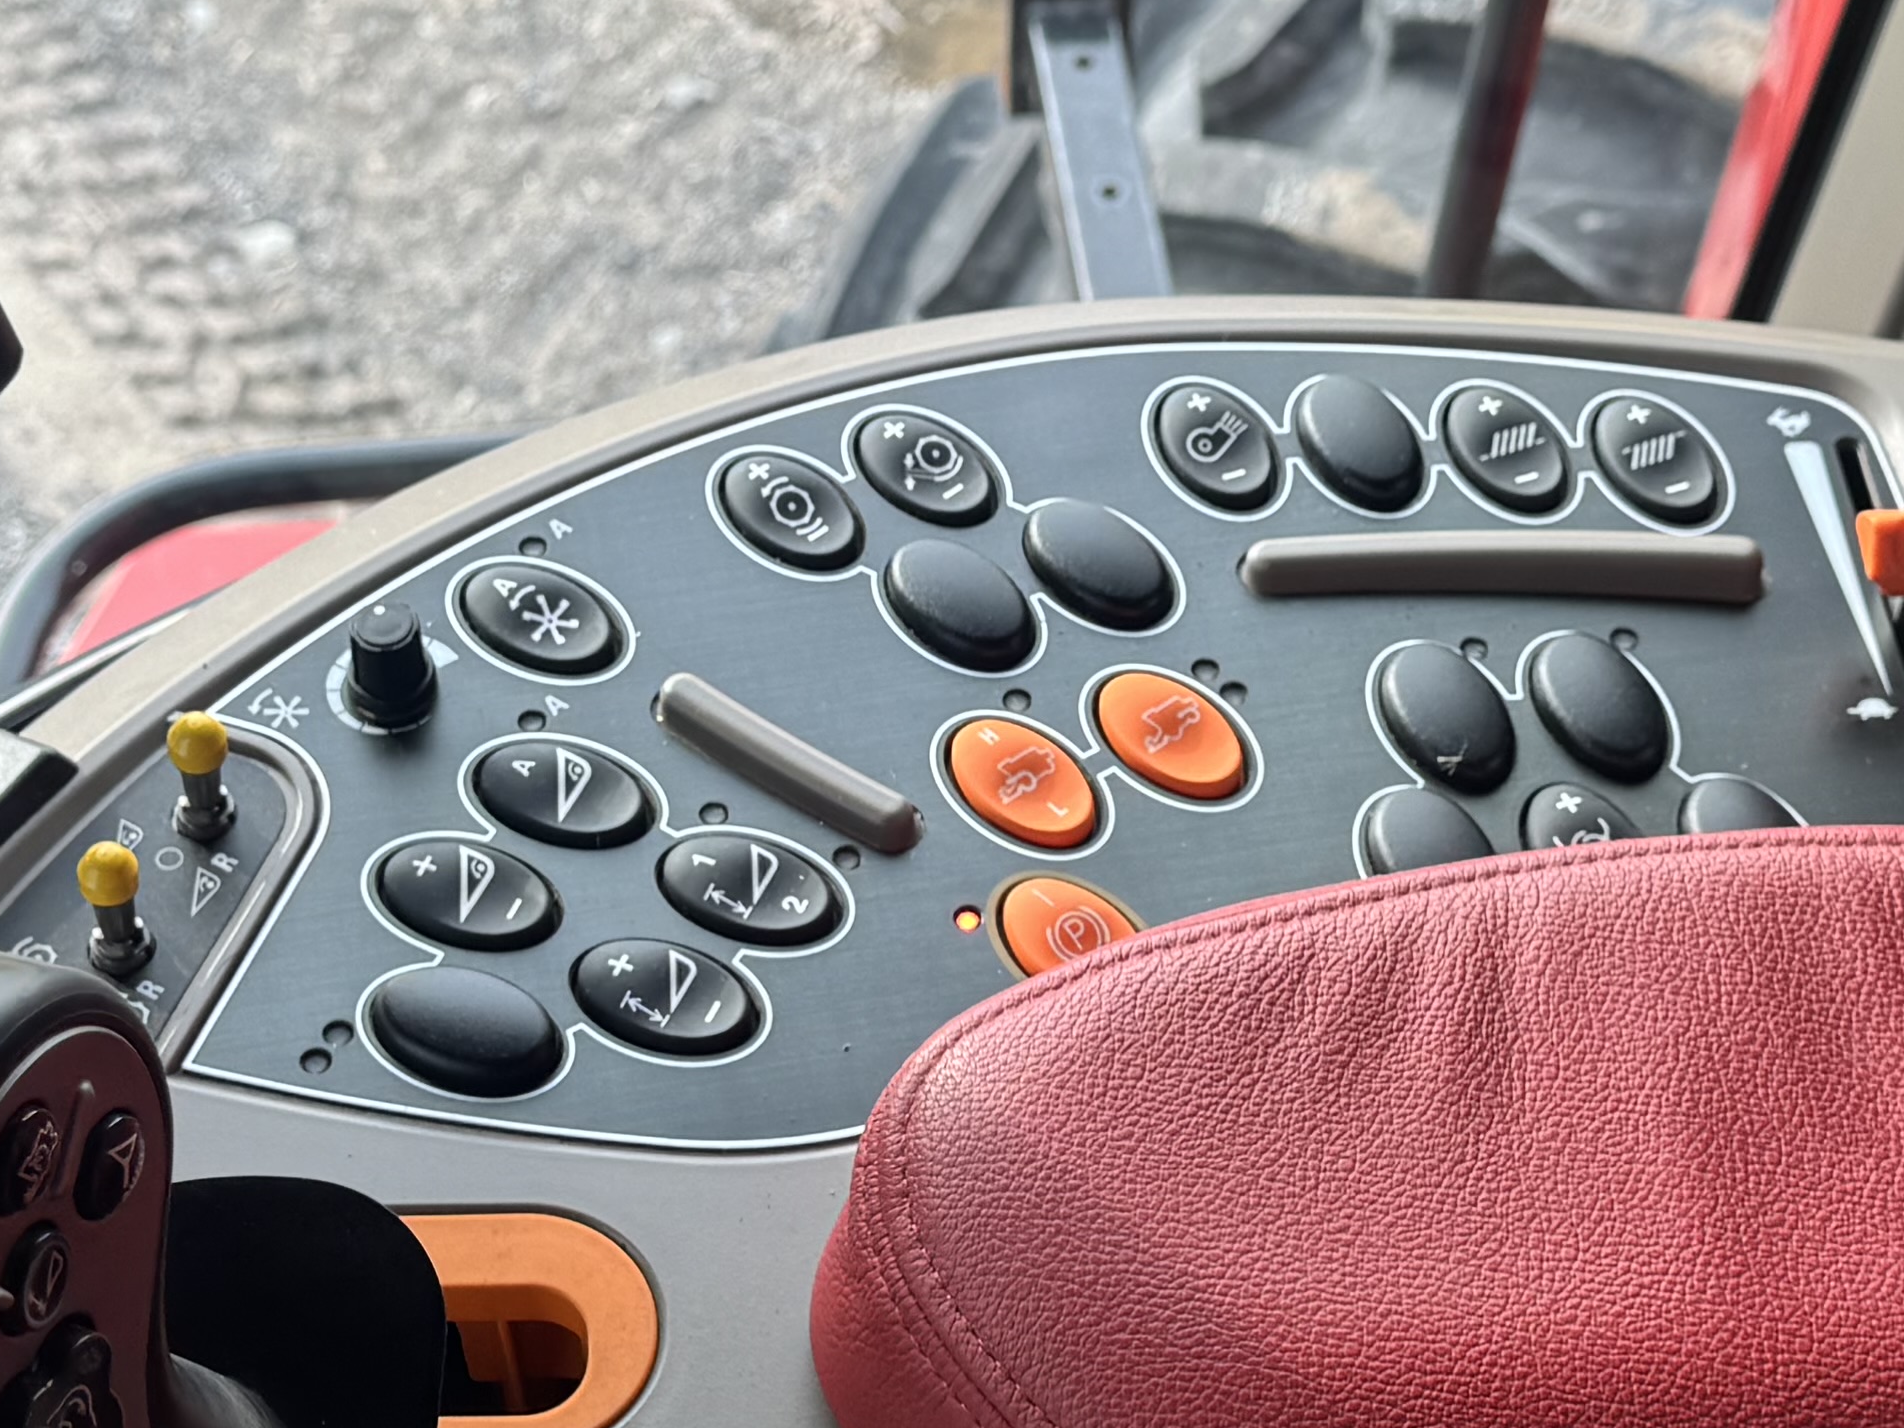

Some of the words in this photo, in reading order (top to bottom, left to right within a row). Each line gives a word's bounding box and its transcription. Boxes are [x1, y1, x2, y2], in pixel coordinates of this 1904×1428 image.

[548, 518, 574, 540] A
[492, 578, 518, 598] A
[544, 695, 570, 717] A
[976, 728, 1001, 746] H
[511, 759, 536, 777] A
[1047, 802, 1069, 818] L
[210, 852, 240, 872] R
[692, 853, 717, 868] 1
[781, 895, 809, 915] 2
[136, 980, 165, 1001] R
